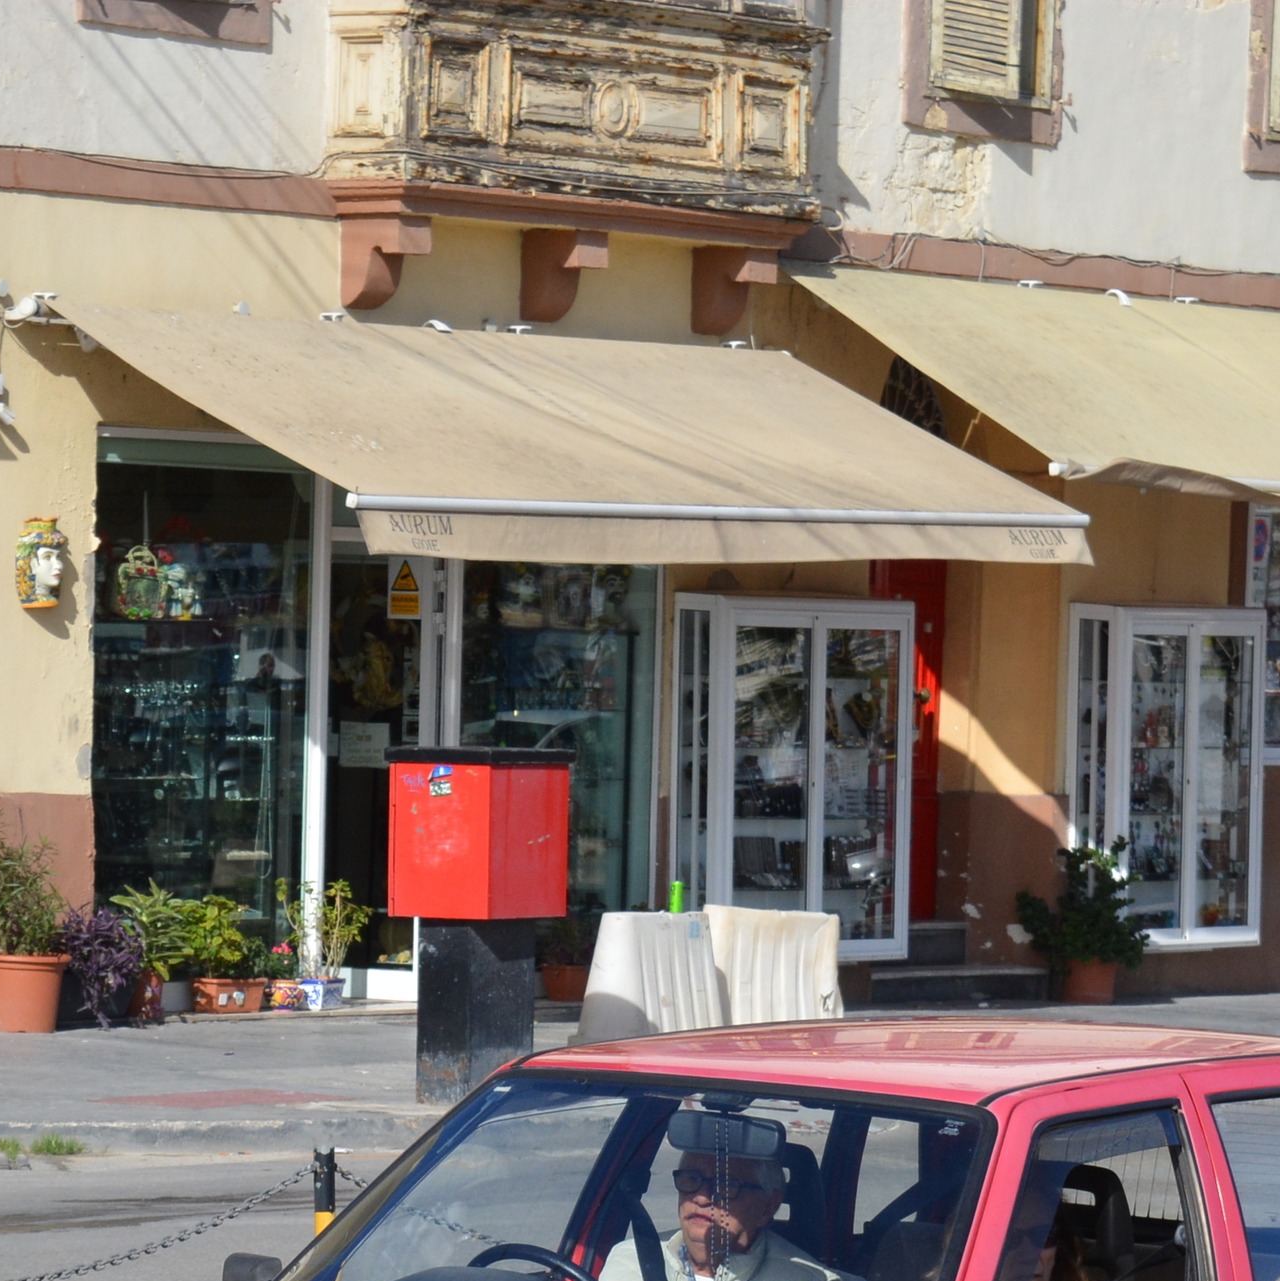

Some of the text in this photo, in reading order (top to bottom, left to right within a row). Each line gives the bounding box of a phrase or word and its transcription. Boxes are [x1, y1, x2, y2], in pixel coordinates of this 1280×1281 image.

[389, 514, 453, 536] AURUM
[411, 538, 440, 552] GIOIE
[1007, 529, 1068, 546] AURUM
